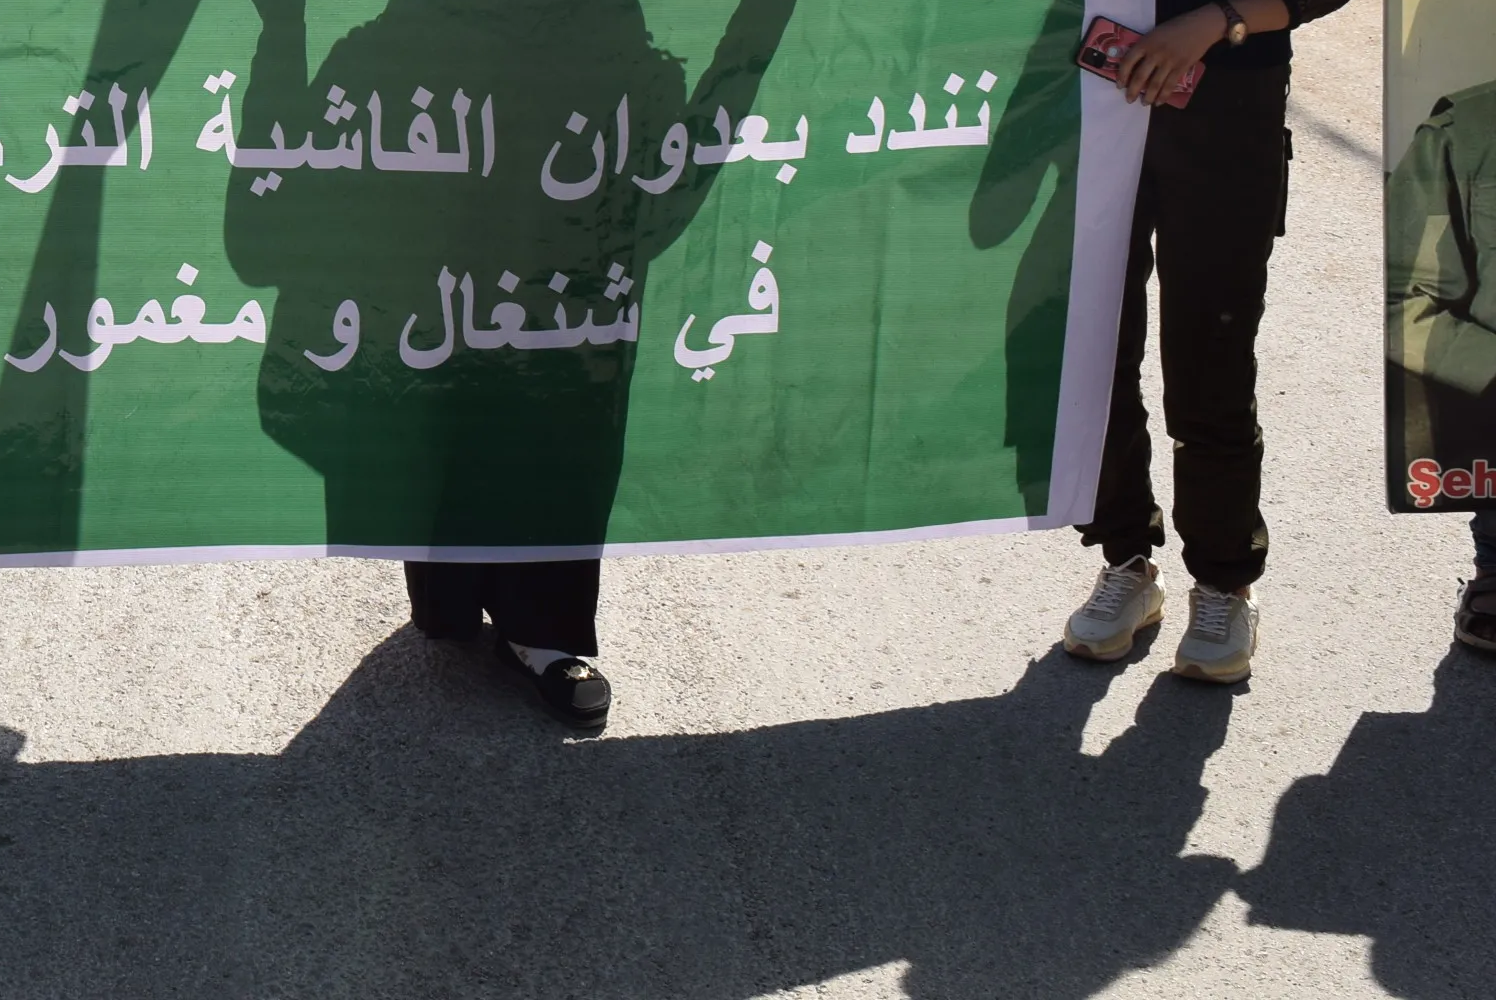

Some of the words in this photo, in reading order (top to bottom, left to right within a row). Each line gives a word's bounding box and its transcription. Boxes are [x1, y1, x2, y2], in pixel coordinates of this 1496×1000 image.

[196, 69, 497, 197] الفاشية
[540, 93, 808, 201] بعدوان
[846, 69, 998, 154] نندد
[3, 262, 267, 372] مغمور
[303, 299, 361, 372] و
[399, 262, 640, 370] شنغال
[673, 240, 780, 382] في
